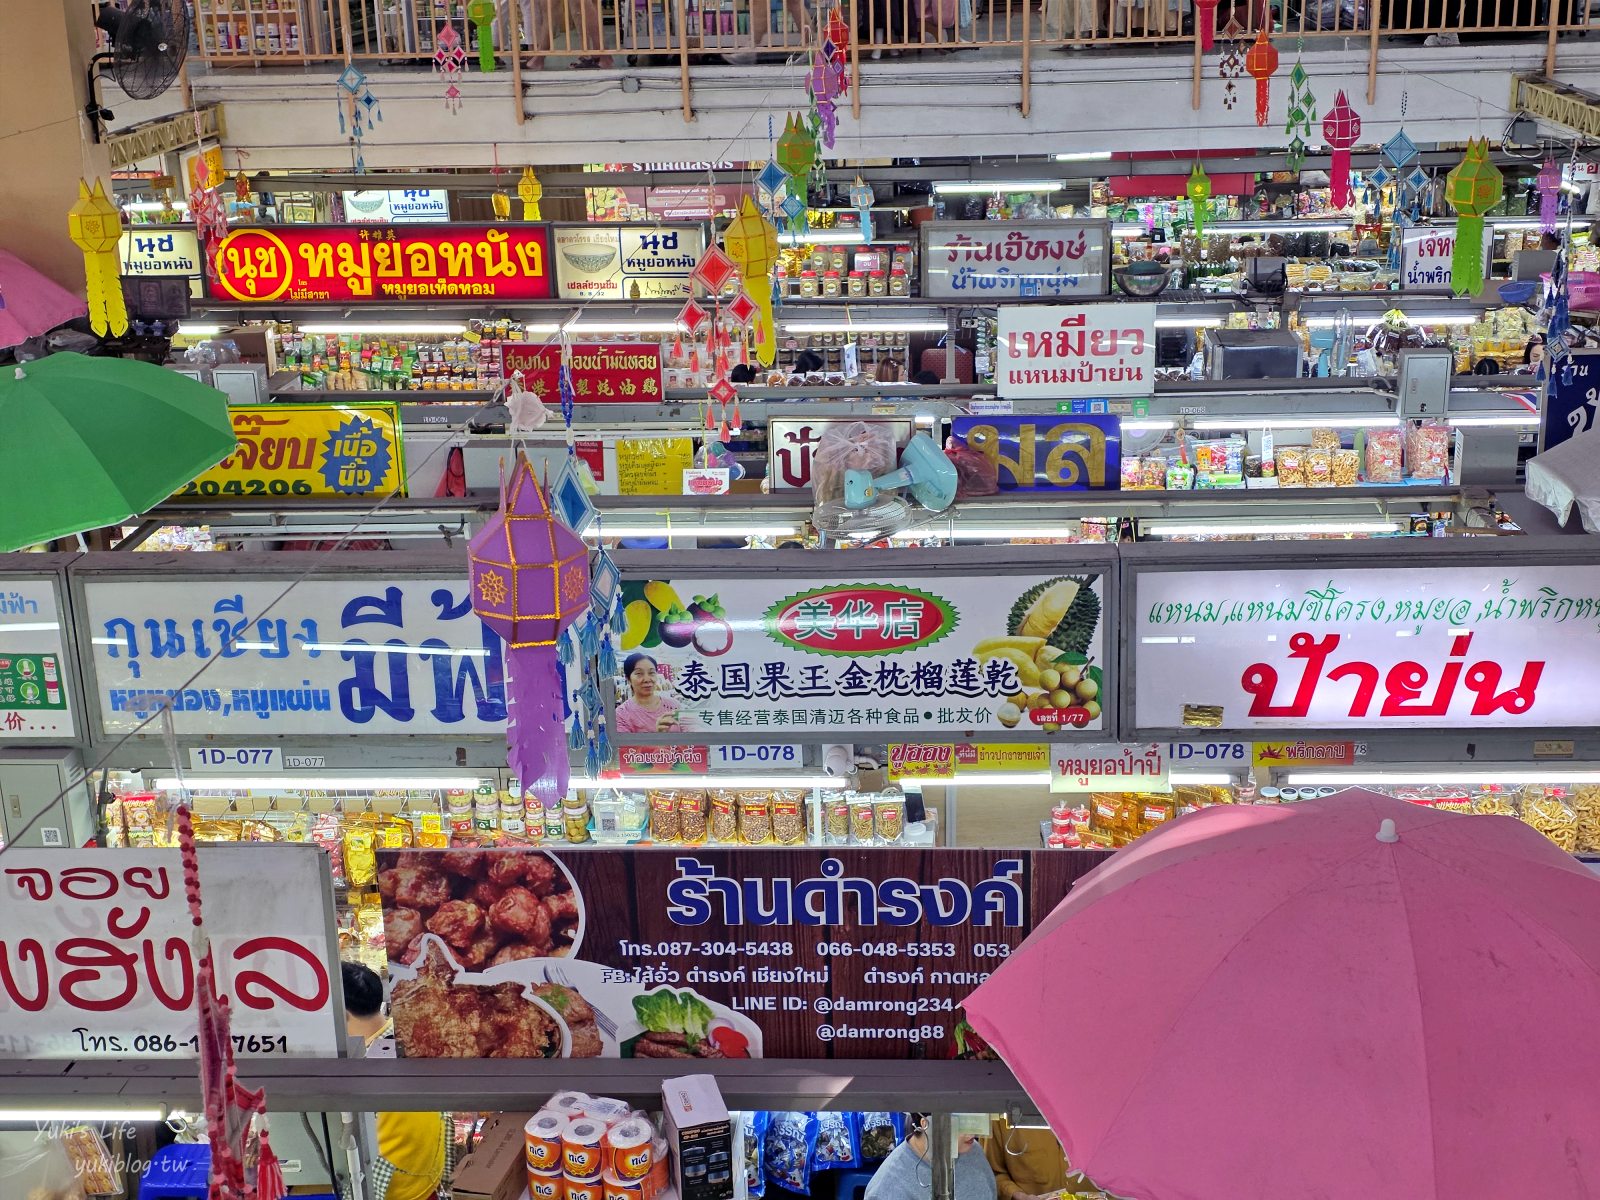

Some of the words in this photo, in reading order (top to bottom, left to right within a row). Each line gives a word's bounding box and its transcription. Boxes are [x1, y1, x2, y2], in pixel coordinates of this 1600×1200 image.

[135, 234, 174, 258] นุช
[640, 231, 678, 256] นุช
[227, 246, 279, 294] นุช
[298, 229, 543, 296] หมูยอหนัง
[626, 254, 696, 272] หมูยอหนัง
[381, 278, 495, 301] หมูยอเห็ดหอม
[1008, 313, 1145, 359] เหมียว
[1009, 358, 1143, 385] แหนมป้าย่น
[333, 427, 378, 457] เนื้อ
[794, 600, 924, 640] 美华店
[104, 594, 322, 678] กุนเชียง
[677, 658, 1020, 698] 泰国果王金枕榴莲乾
[1241, 631, 1546, 718] ป้าย่น
[1062, 713, 1083, 722] 1/77
[198, 749, 273, 765] 1D-077
[718, 745, 795, 761] 1D-078
[1285, 740, 1346, 759] พริกลาบ
[286, 757, 324, 767] 1D-077
[666, 857, 1024, 926] ร้านดำรงค์
[619, 939, 793, 956] โทร.087-304-5438
[816, 942, 956, 957] 066-048-5353
[686, 966, 746, 984] ดำรงค์
[752, 965, 829, 984] เชียงใหม่
[864, 966, 924, 984] ดำรงค์
[732, 996, 777, 1011] LINE
[782, 996, 807, 1011] ID:
[813, 996, 954, 1016] @damrong234
[816, 1024, 944, 1043] @damrong88
